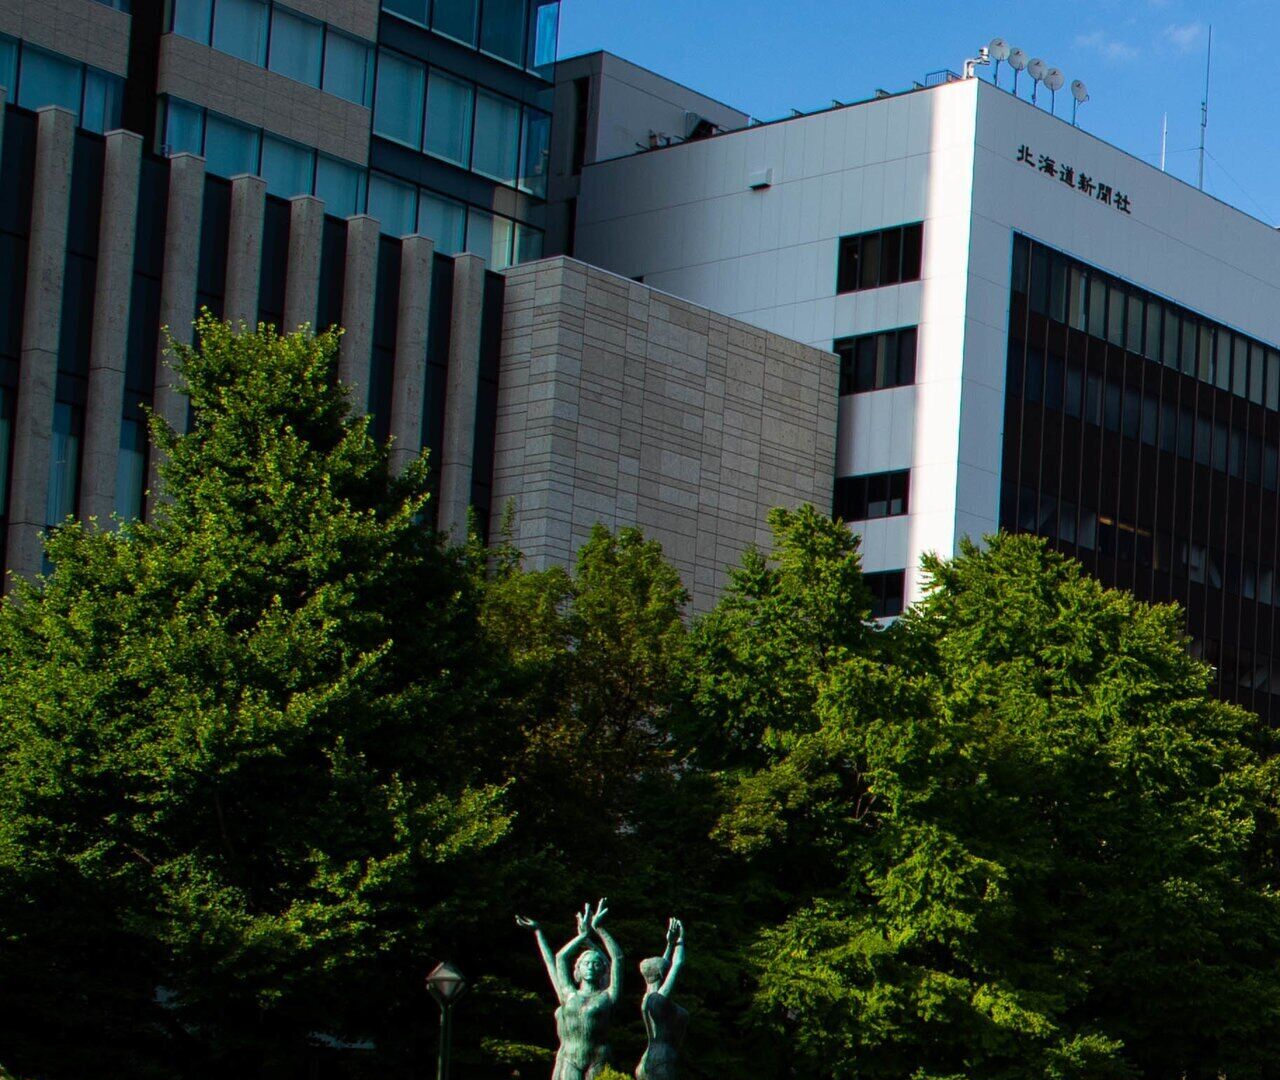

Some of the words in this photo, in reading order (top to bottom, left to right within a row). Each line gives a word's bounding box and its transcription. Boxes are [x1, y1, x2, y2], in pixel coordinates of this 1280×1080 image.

[1016, 144, 1132, 214] 北海道新聞社
